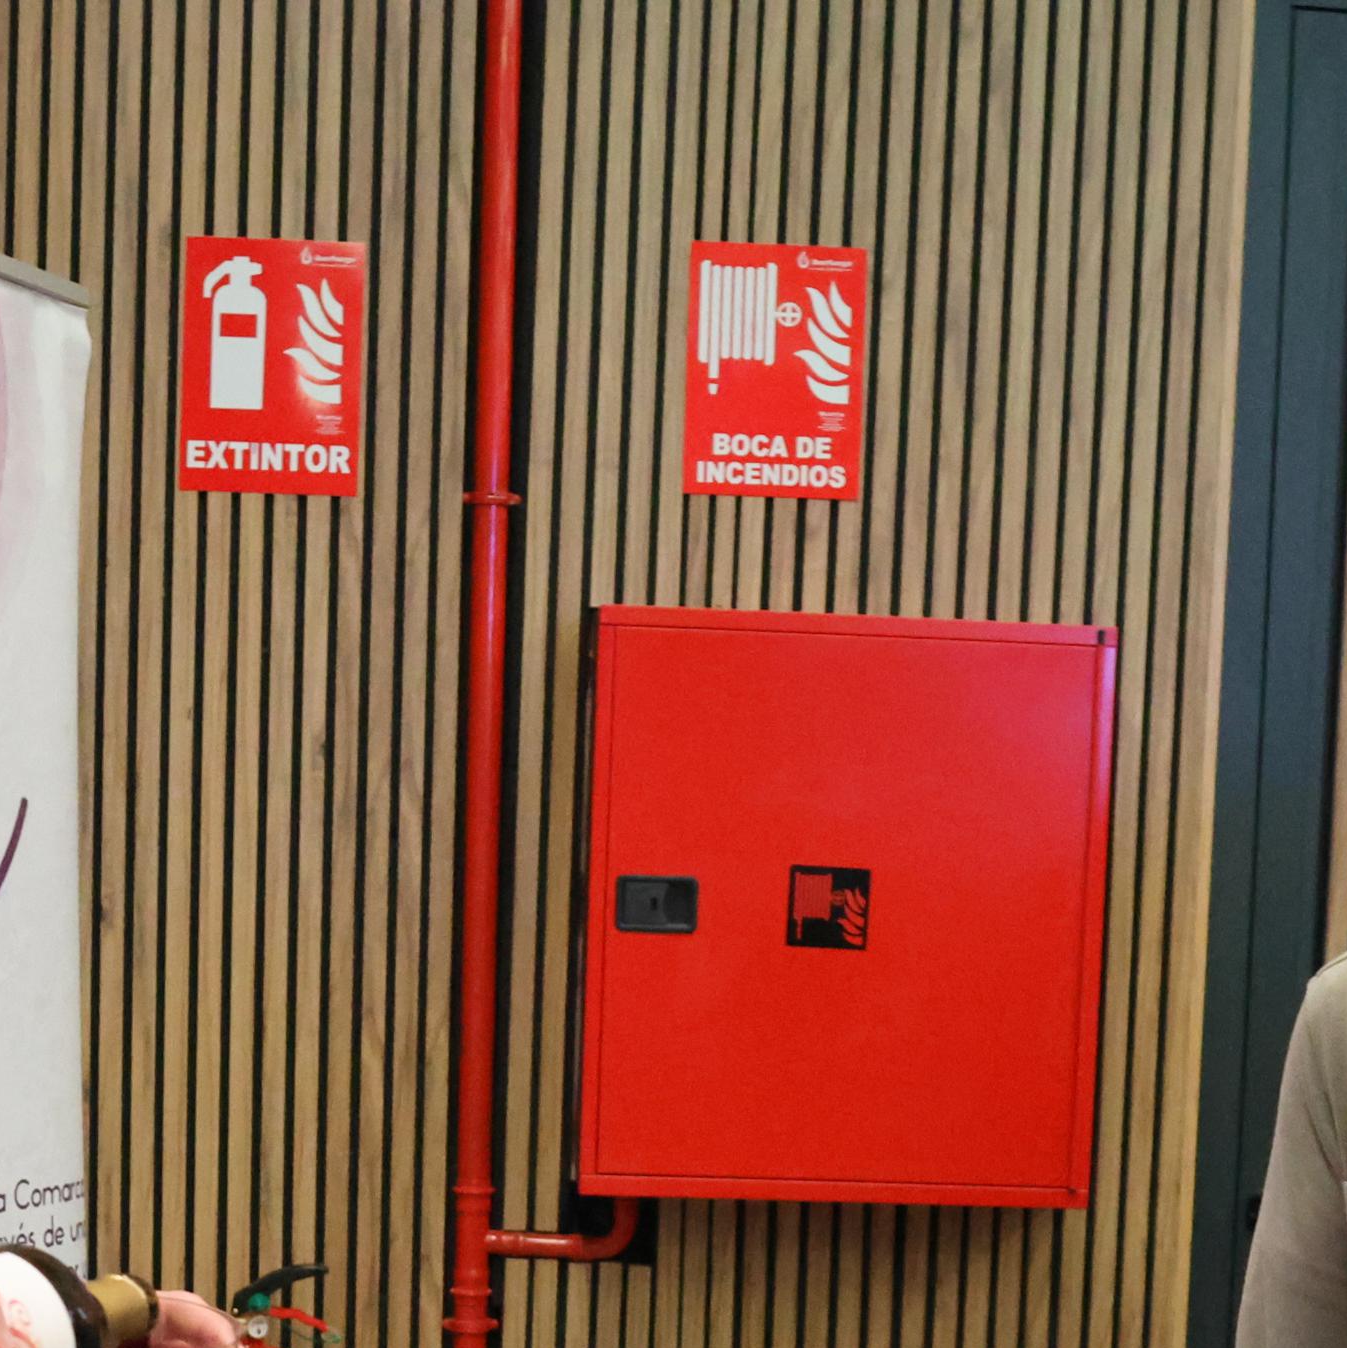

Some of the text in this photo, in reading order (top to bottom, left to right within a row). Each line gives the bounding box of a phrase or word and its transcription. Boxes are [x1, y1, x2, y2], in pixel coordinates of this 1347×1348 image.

[186, 439, 351, 474] EXTINTOR
[712, 432, 832, 459] BOCA DE
[696, 460, 847, 488] INCENDIOS
[43, 1215, 65, 1247] de
